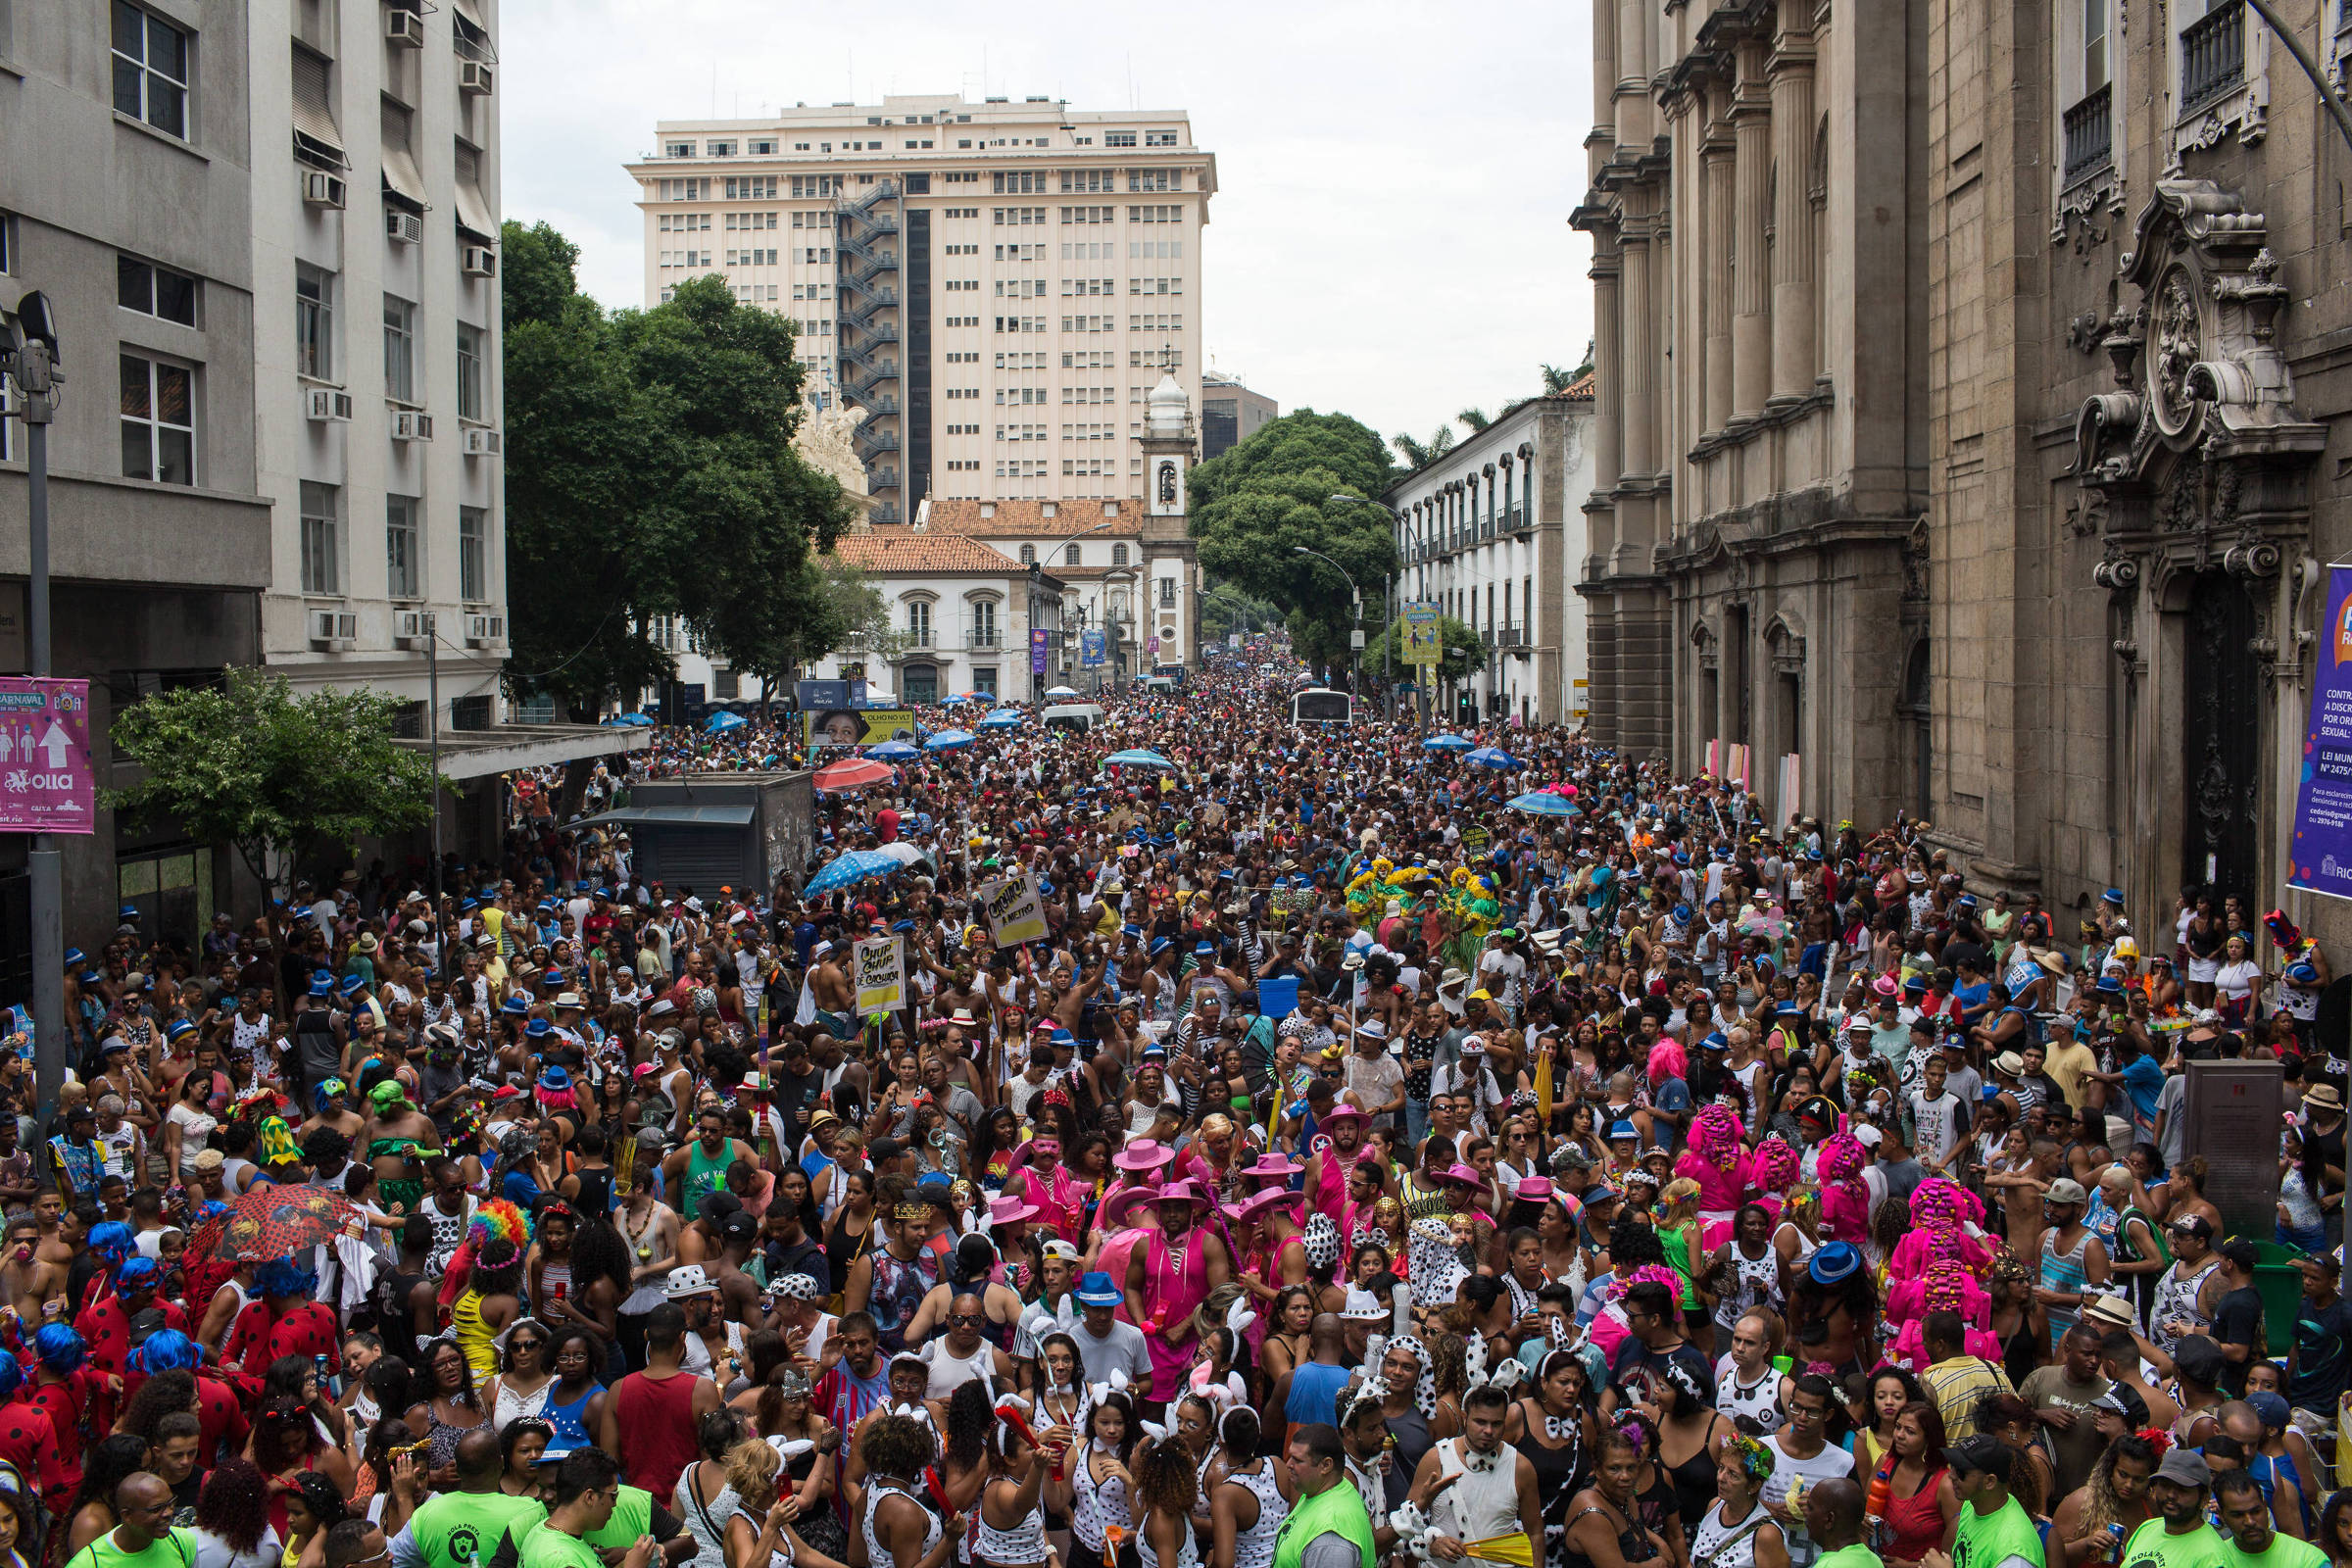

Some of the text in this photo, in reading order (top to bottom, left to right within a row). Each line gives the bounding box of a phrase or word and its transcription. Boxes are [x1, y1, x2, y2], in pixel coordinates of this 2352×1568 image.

[2342, 631, 2352, 645] R
[0, 694, 43, 706] ARNAVAL
[2327, 689, 2352, 700] CONTR
[2325, 702, 2330, 711] A
[2323, 713, 2338, 724] POR
[2321, 726, 2350, 738] SEXUAL:
[2322, 751, 2333, 760] LEI
[447, 1523, 463, 1537] BOLA
